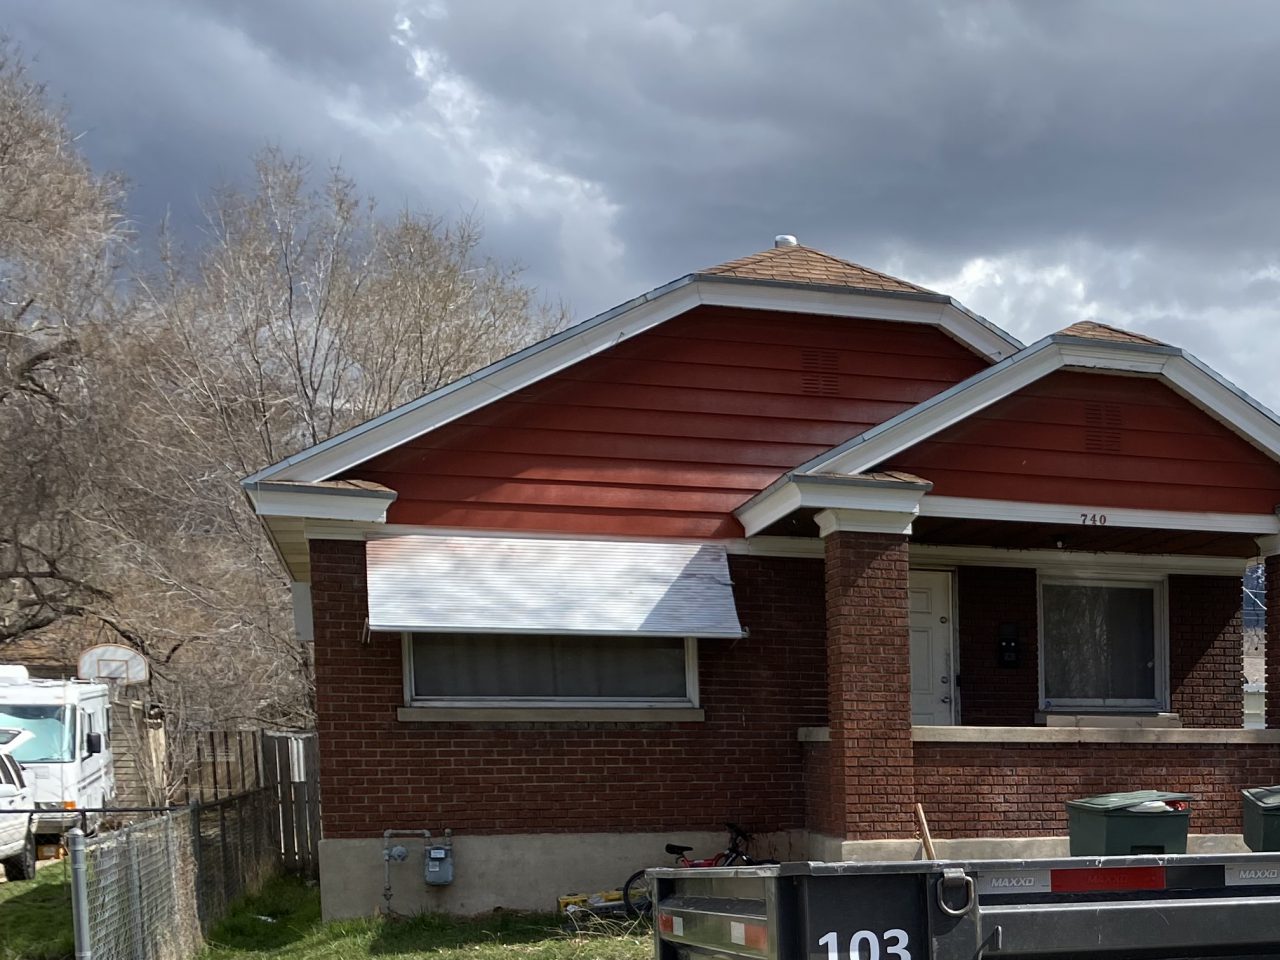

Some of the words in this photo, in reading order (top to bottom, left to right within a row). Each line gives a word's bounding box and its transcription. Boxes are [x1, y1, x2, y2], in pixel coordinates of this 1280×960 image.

[1080, 513, 1107, 526] 740
[1239, 868, 1278, 879] MAXXD
[991, 876, 1035, 888] MAXXD
